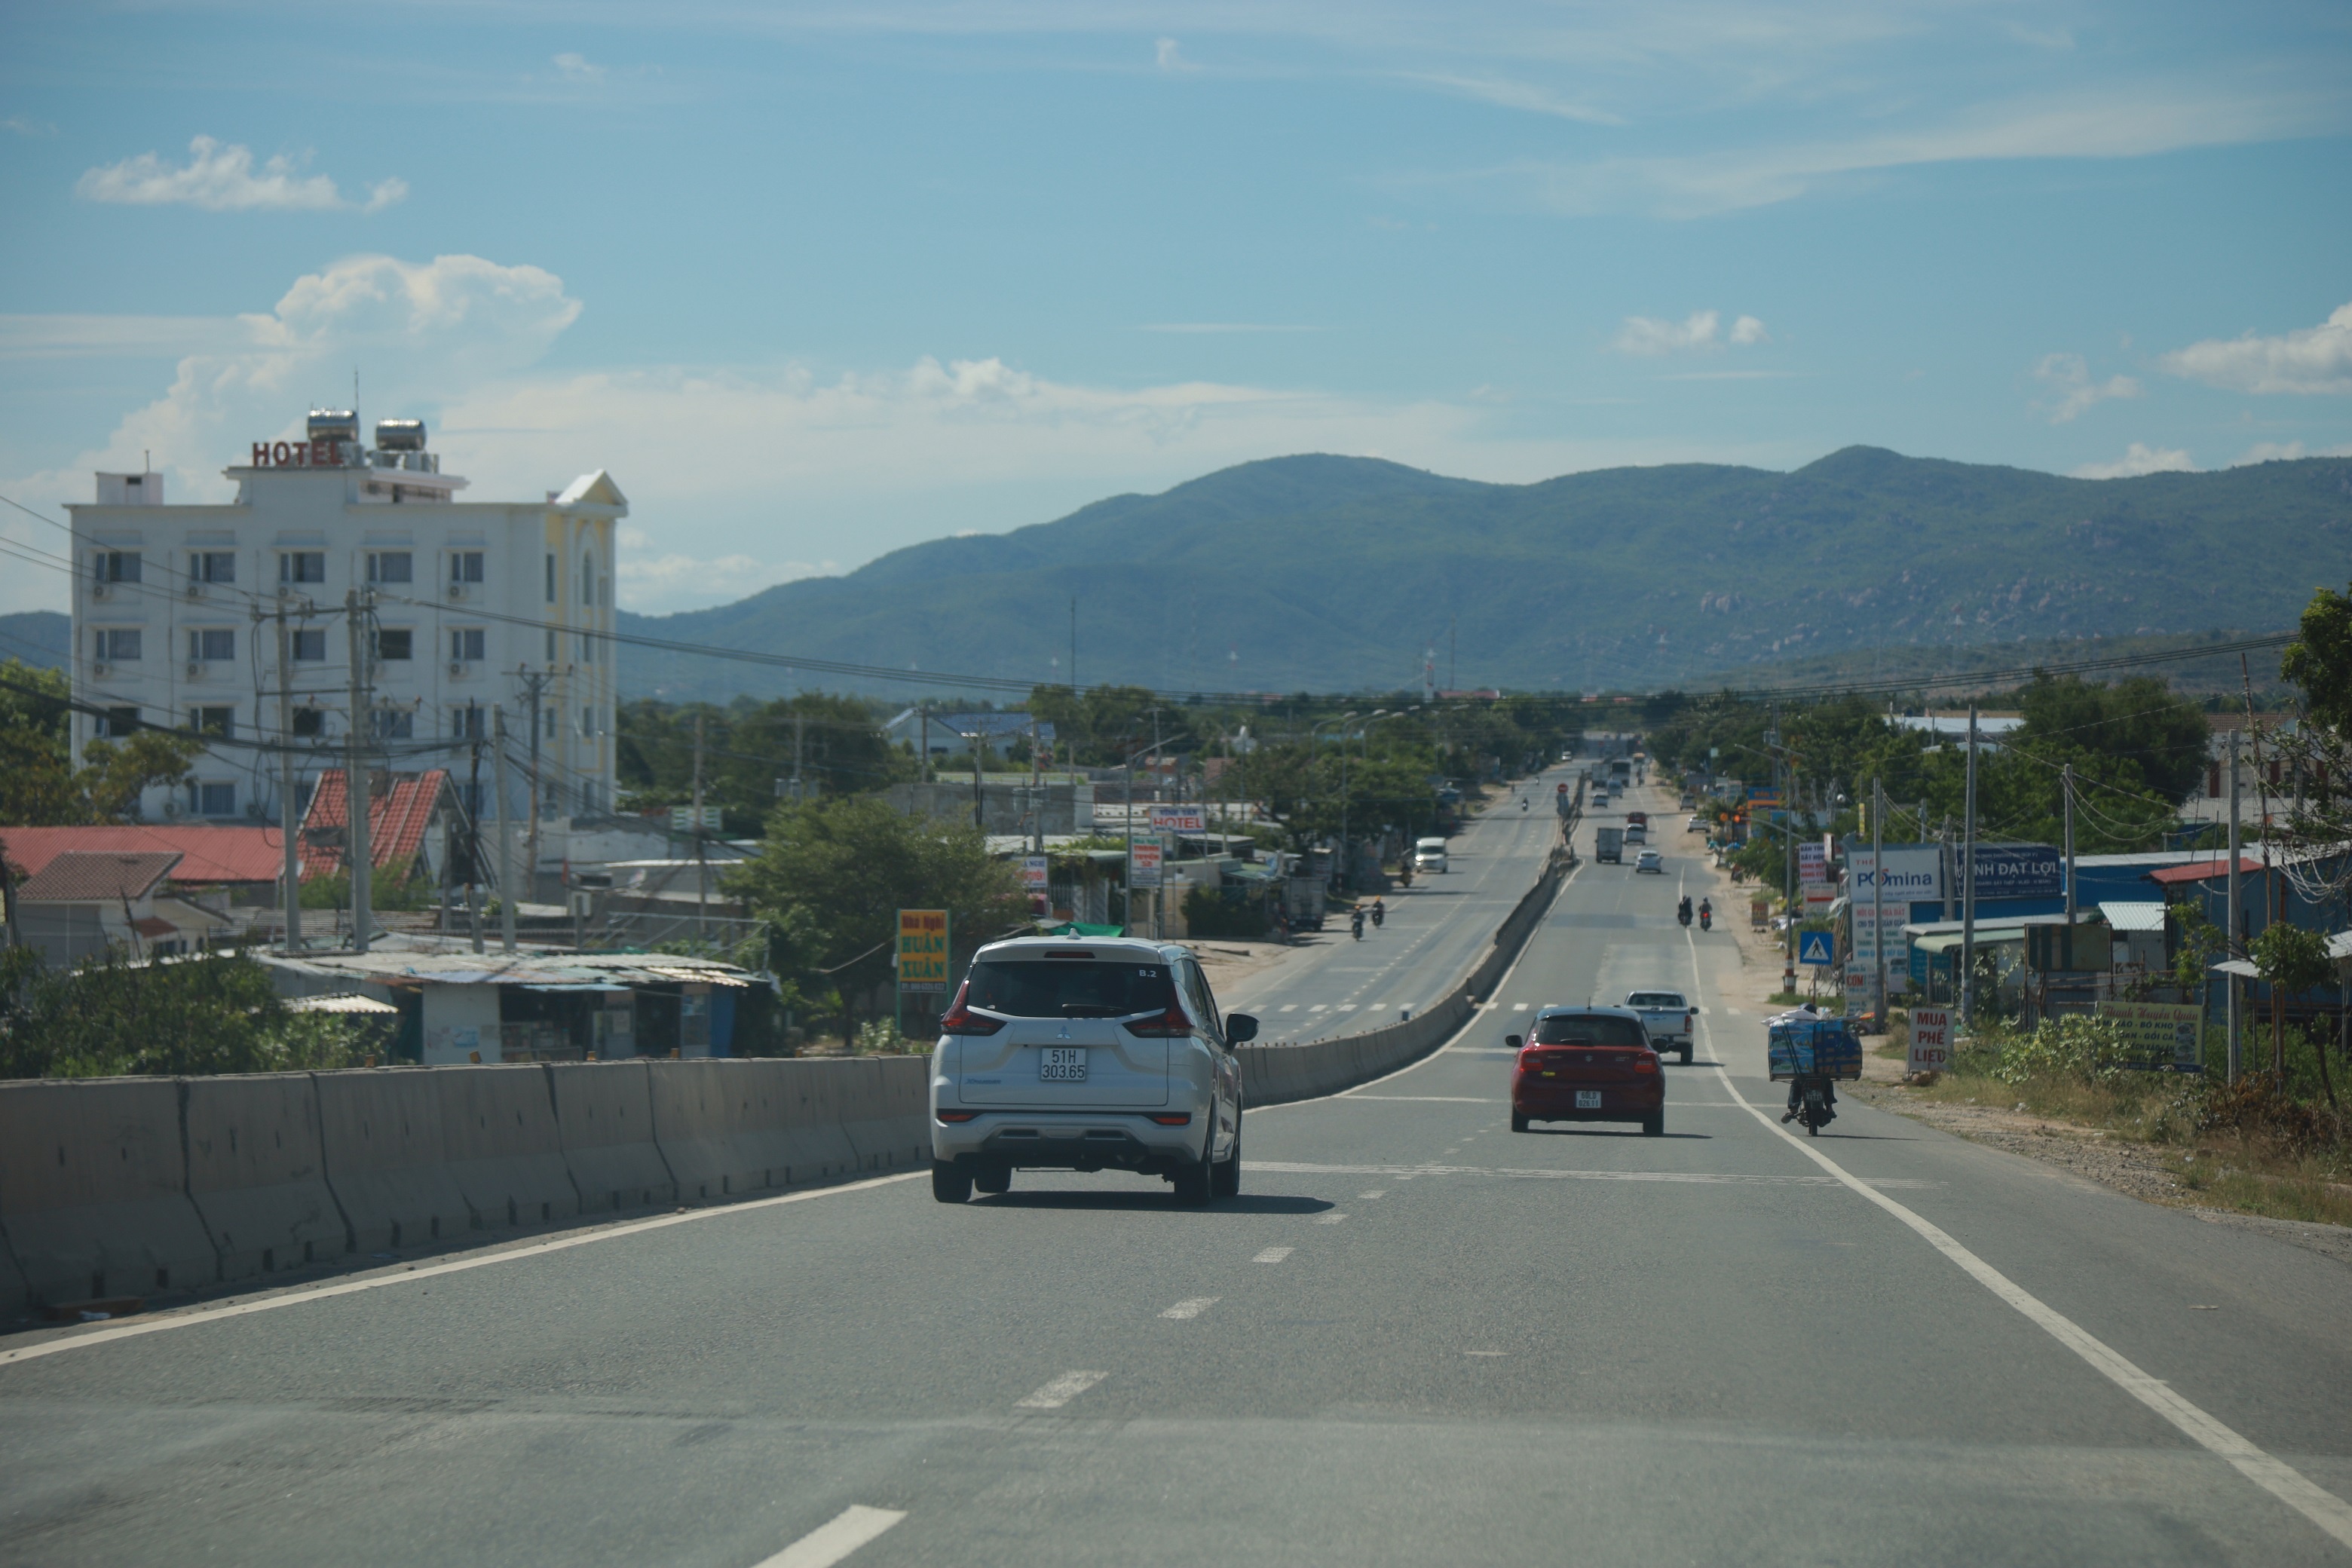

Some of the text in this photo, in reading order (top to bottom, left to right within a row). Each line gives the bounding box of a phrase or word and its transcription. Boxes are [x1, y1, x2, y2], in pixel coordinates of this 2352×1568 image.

[253, 441, 344, 467] HOTEL
[1153, 817, 1202, 828] HOTEL
[1856, 858, 1875, 866] THÉ
[1998, 862, 2028, 878] ĐẠT
[2032, 862, 2056, 876] LỢI
[902, 932, 944, 954] HUÂN
[902, 957, 944, 978] XUÂN
[1139, 969, 1157, 978] B.2
[1917, 1012, 1947, 1026] MUA
[2103, 1006, 2133, 1018] Thanh
[2173, 1008, 2198, 1021] Quán
[2154, 1021, 2174, 1030] KHO
[1052, 1050, 1076, 1064] 51H
[1042, 1064, 1086, 1079] 303.65
